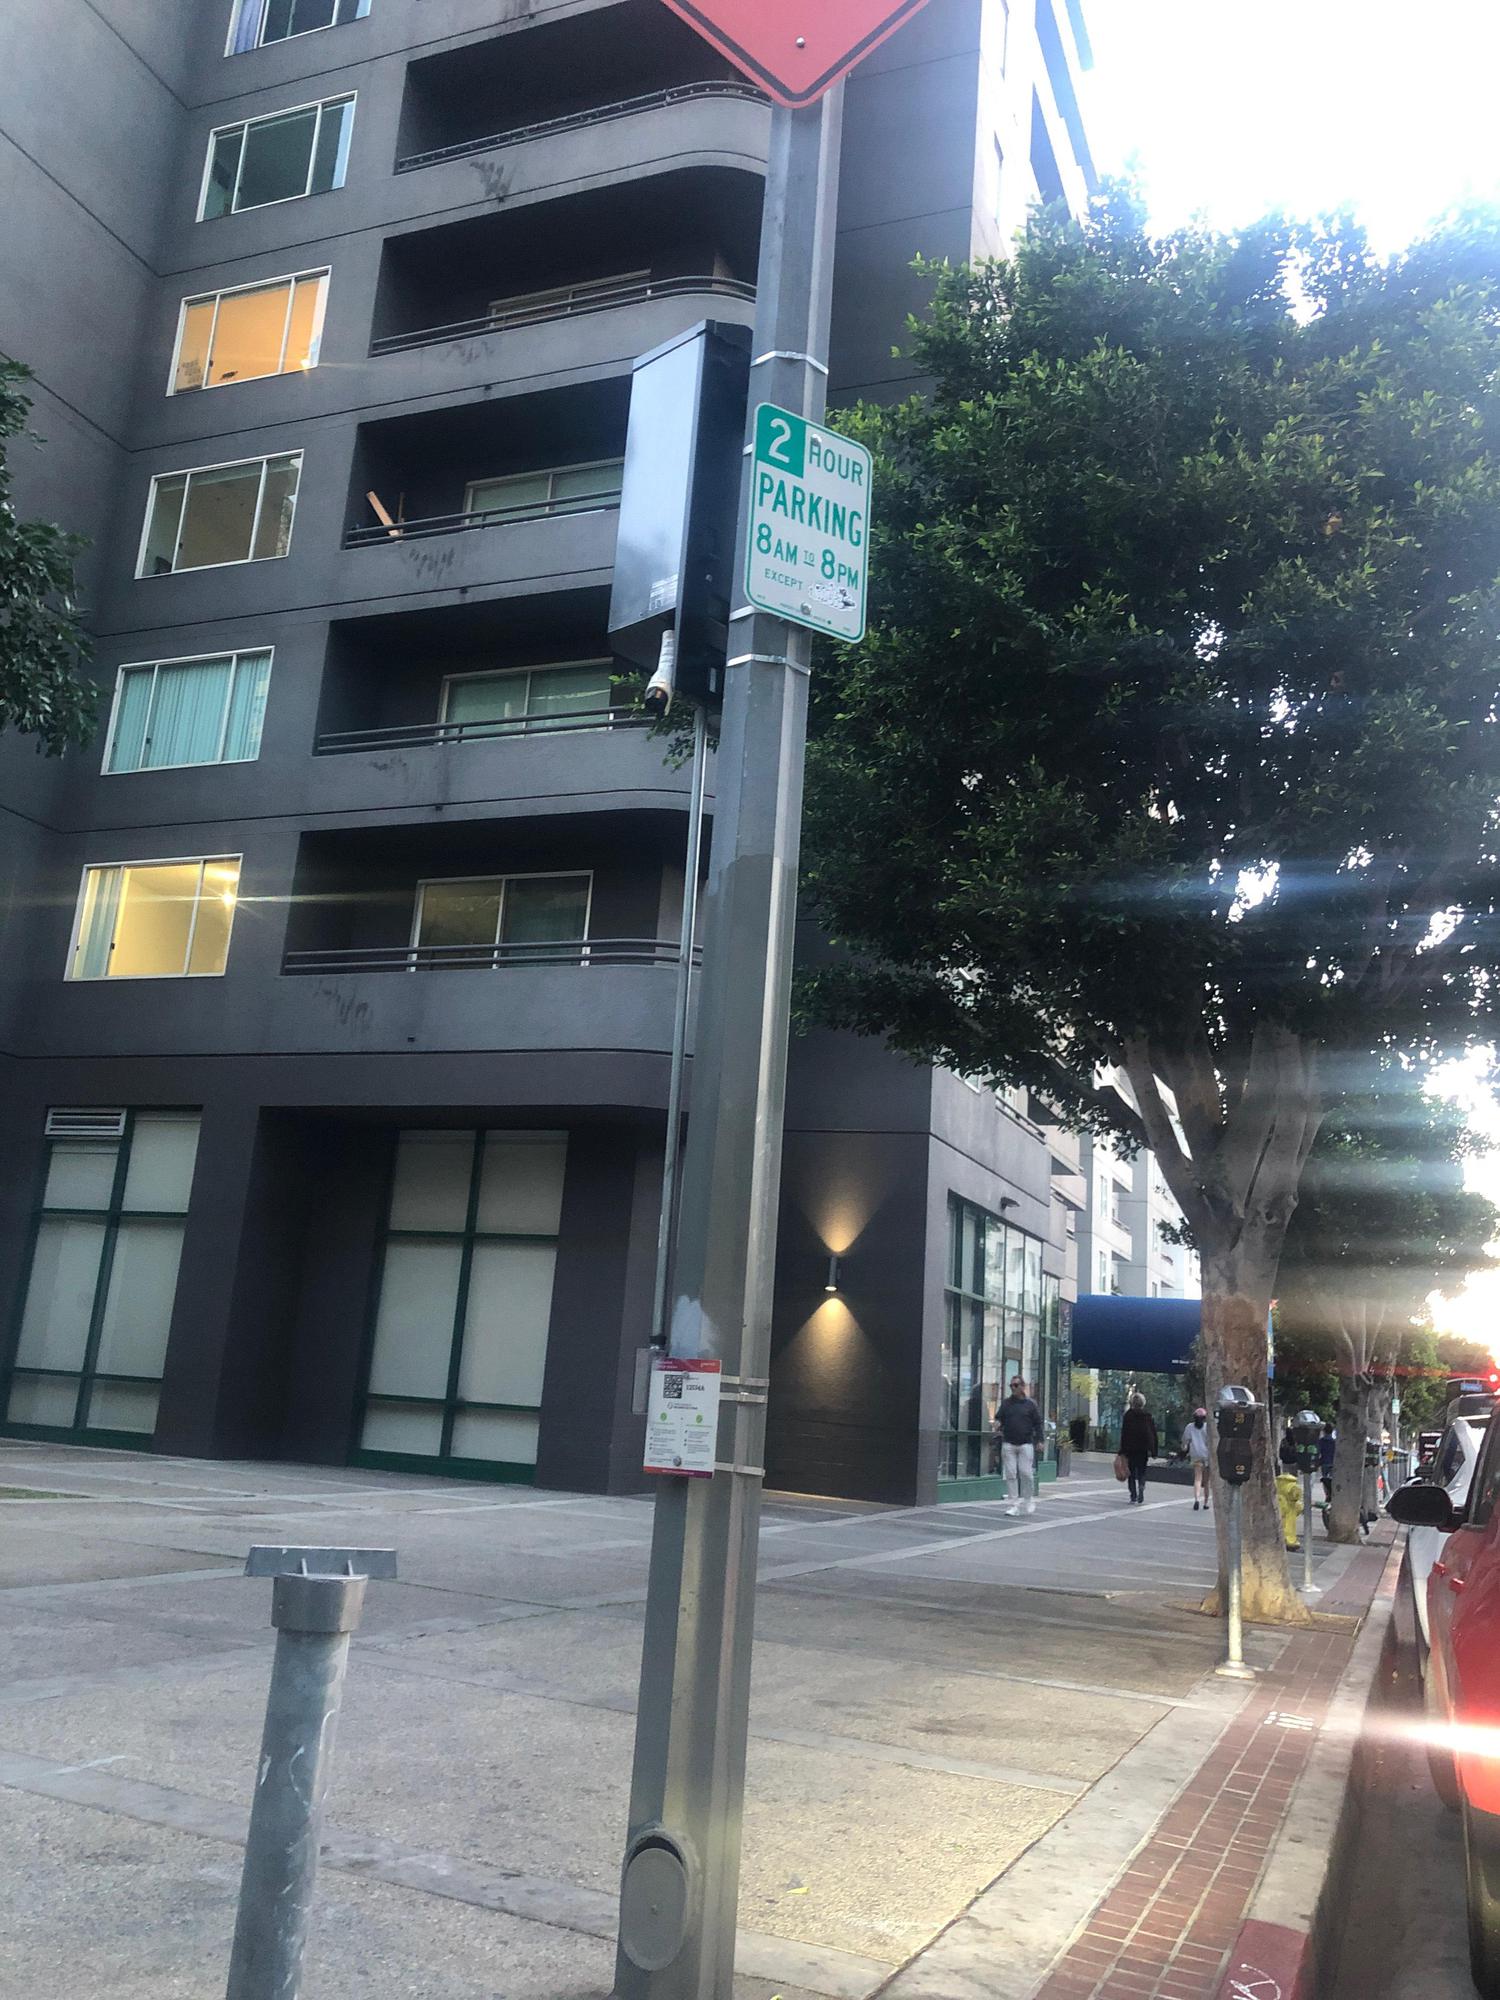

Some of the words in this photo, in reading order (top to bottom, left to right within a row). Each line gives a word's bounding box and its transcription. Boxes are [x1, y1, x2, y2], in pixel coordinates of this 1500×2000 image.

[768, 418, 792, 463] 2
[808, 440, 864, 486] HOUR
[758, 472, 862, 547] PARKING
[764, 568, 803, 591] EXCEPT
